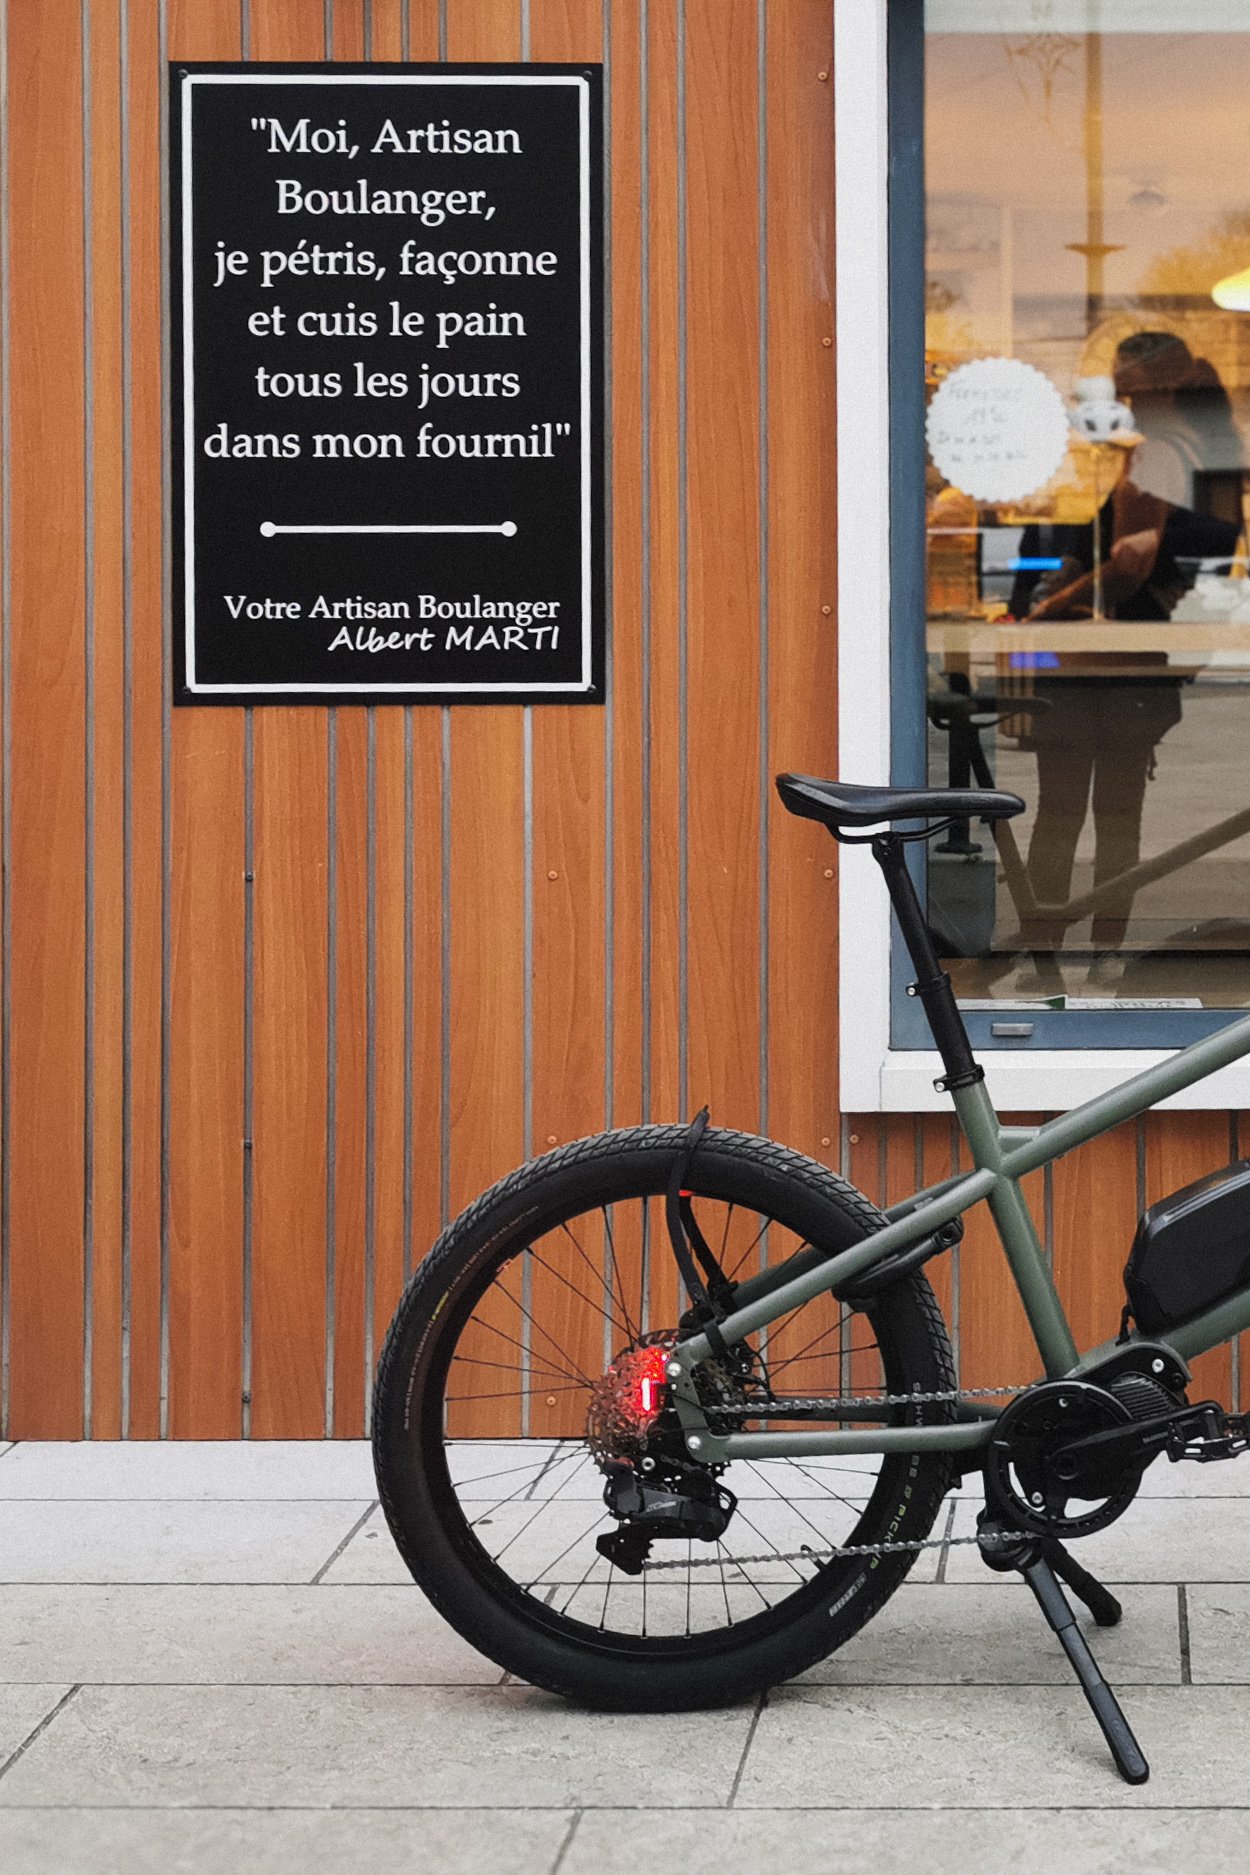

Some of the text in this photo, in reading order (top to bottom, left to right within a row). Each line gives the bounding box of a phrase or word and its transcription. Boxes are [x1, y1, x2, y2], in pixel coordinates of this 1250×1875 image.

[250, 117, 523, 160] "Moi, Artisan
[275, 178, 496, 227] Boulanger,
[212, 238, 558, 288] je pétris, façonne
[247, 300, 528, 349] et cuis le pain
[254, 361, 521, 410] tous les jours
[203, 422, 571, 459] dans mon fournil"
[223, 594, 561, 628] Votre Artisan Boulanger
[327, 621, 560, 654] Albert MARTI
